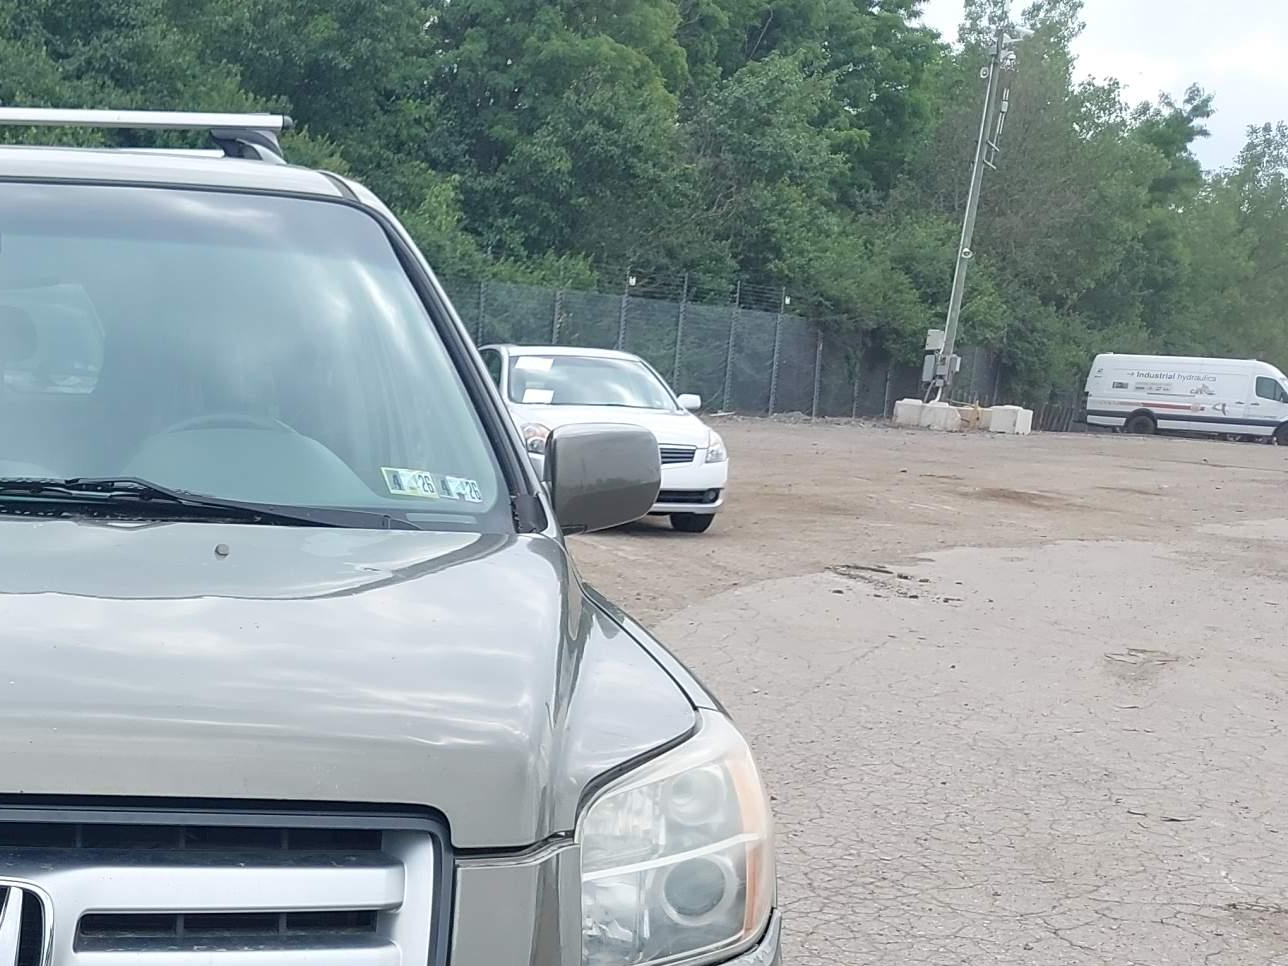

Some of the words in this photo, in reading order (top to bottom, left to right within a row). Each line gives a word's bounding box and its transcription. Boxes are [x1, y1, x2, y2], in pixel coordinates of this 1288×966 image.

[1136, 371, 1176, 380] Industrial
[417, 474, 436, 494] 26
[465, 480, 482, 500] 26
